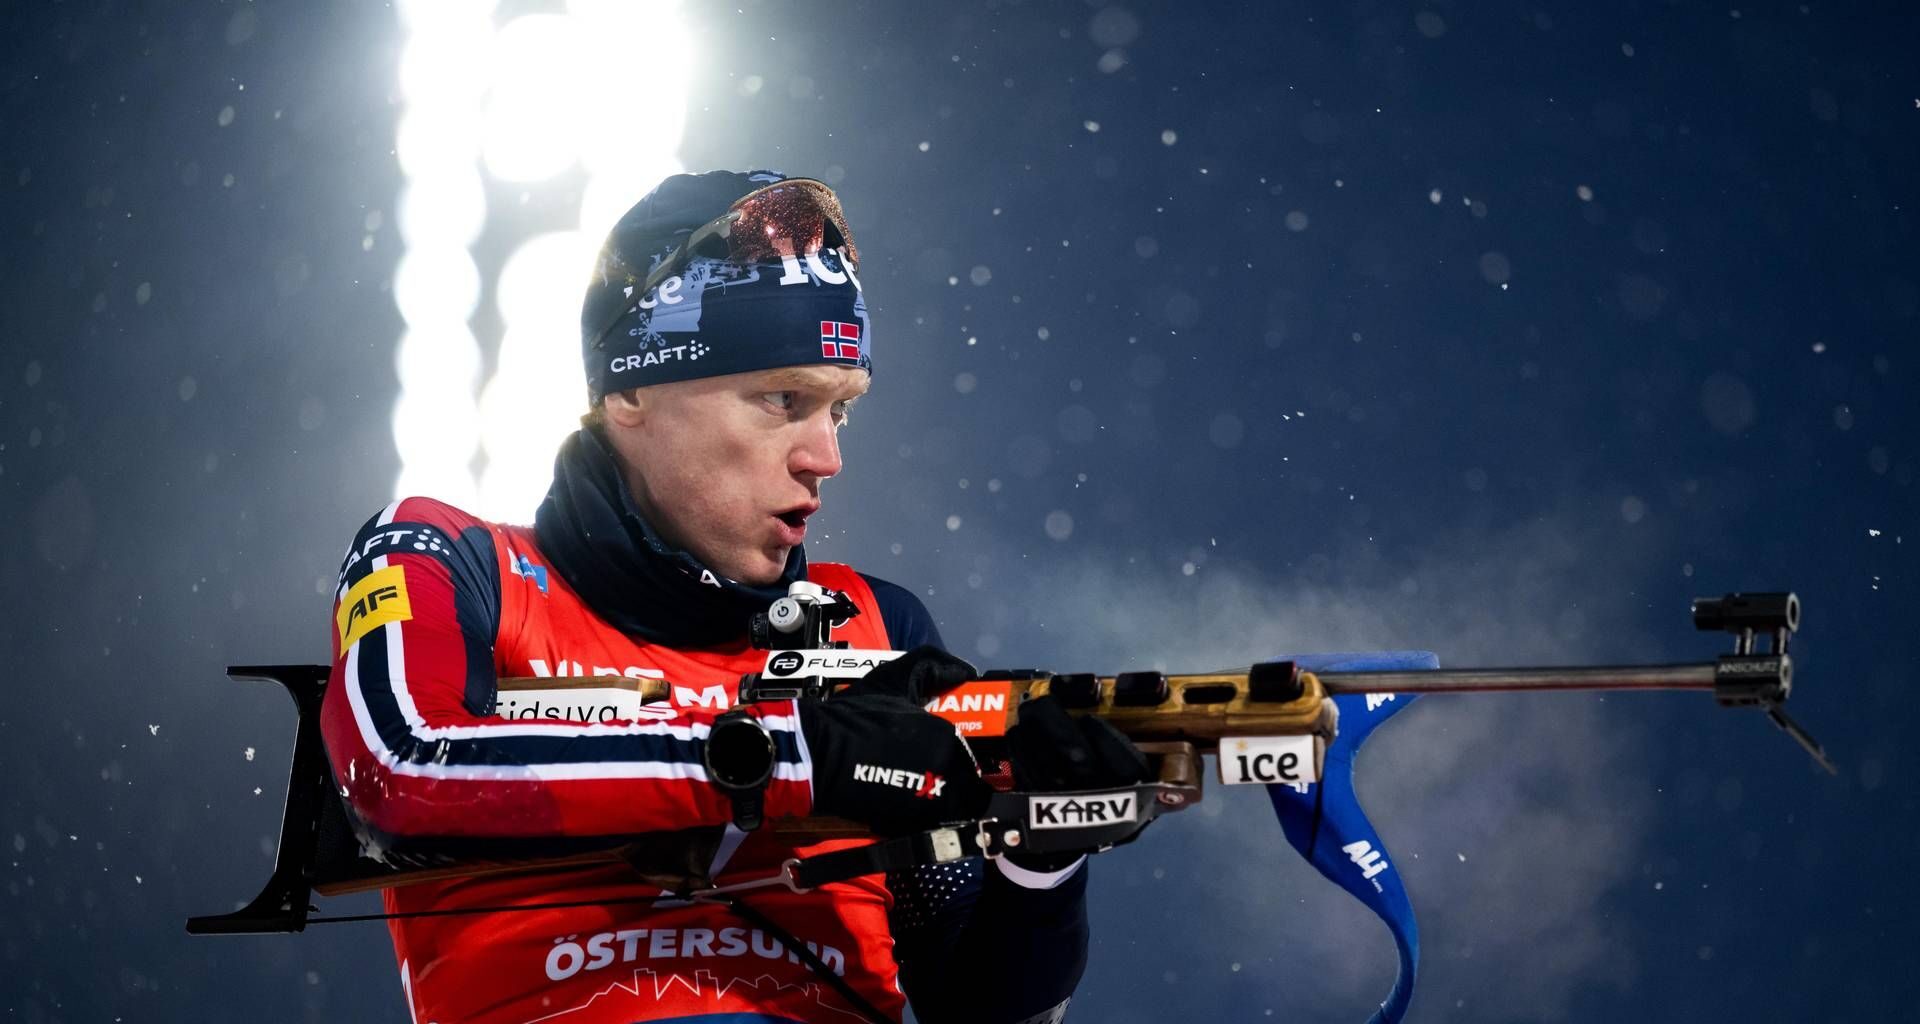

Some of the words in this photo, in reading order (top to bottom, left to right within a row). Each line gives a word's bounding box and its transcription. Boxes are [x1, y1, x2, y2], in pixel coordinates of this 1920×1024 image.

[610, 345, 687, 373] CRAFT
[336, 530, 414, 582] AFT
[346, 585, 398, 642] AF
[807, 658, 886, 669] FLISA
[1236, 751, 1300, 783] ice
